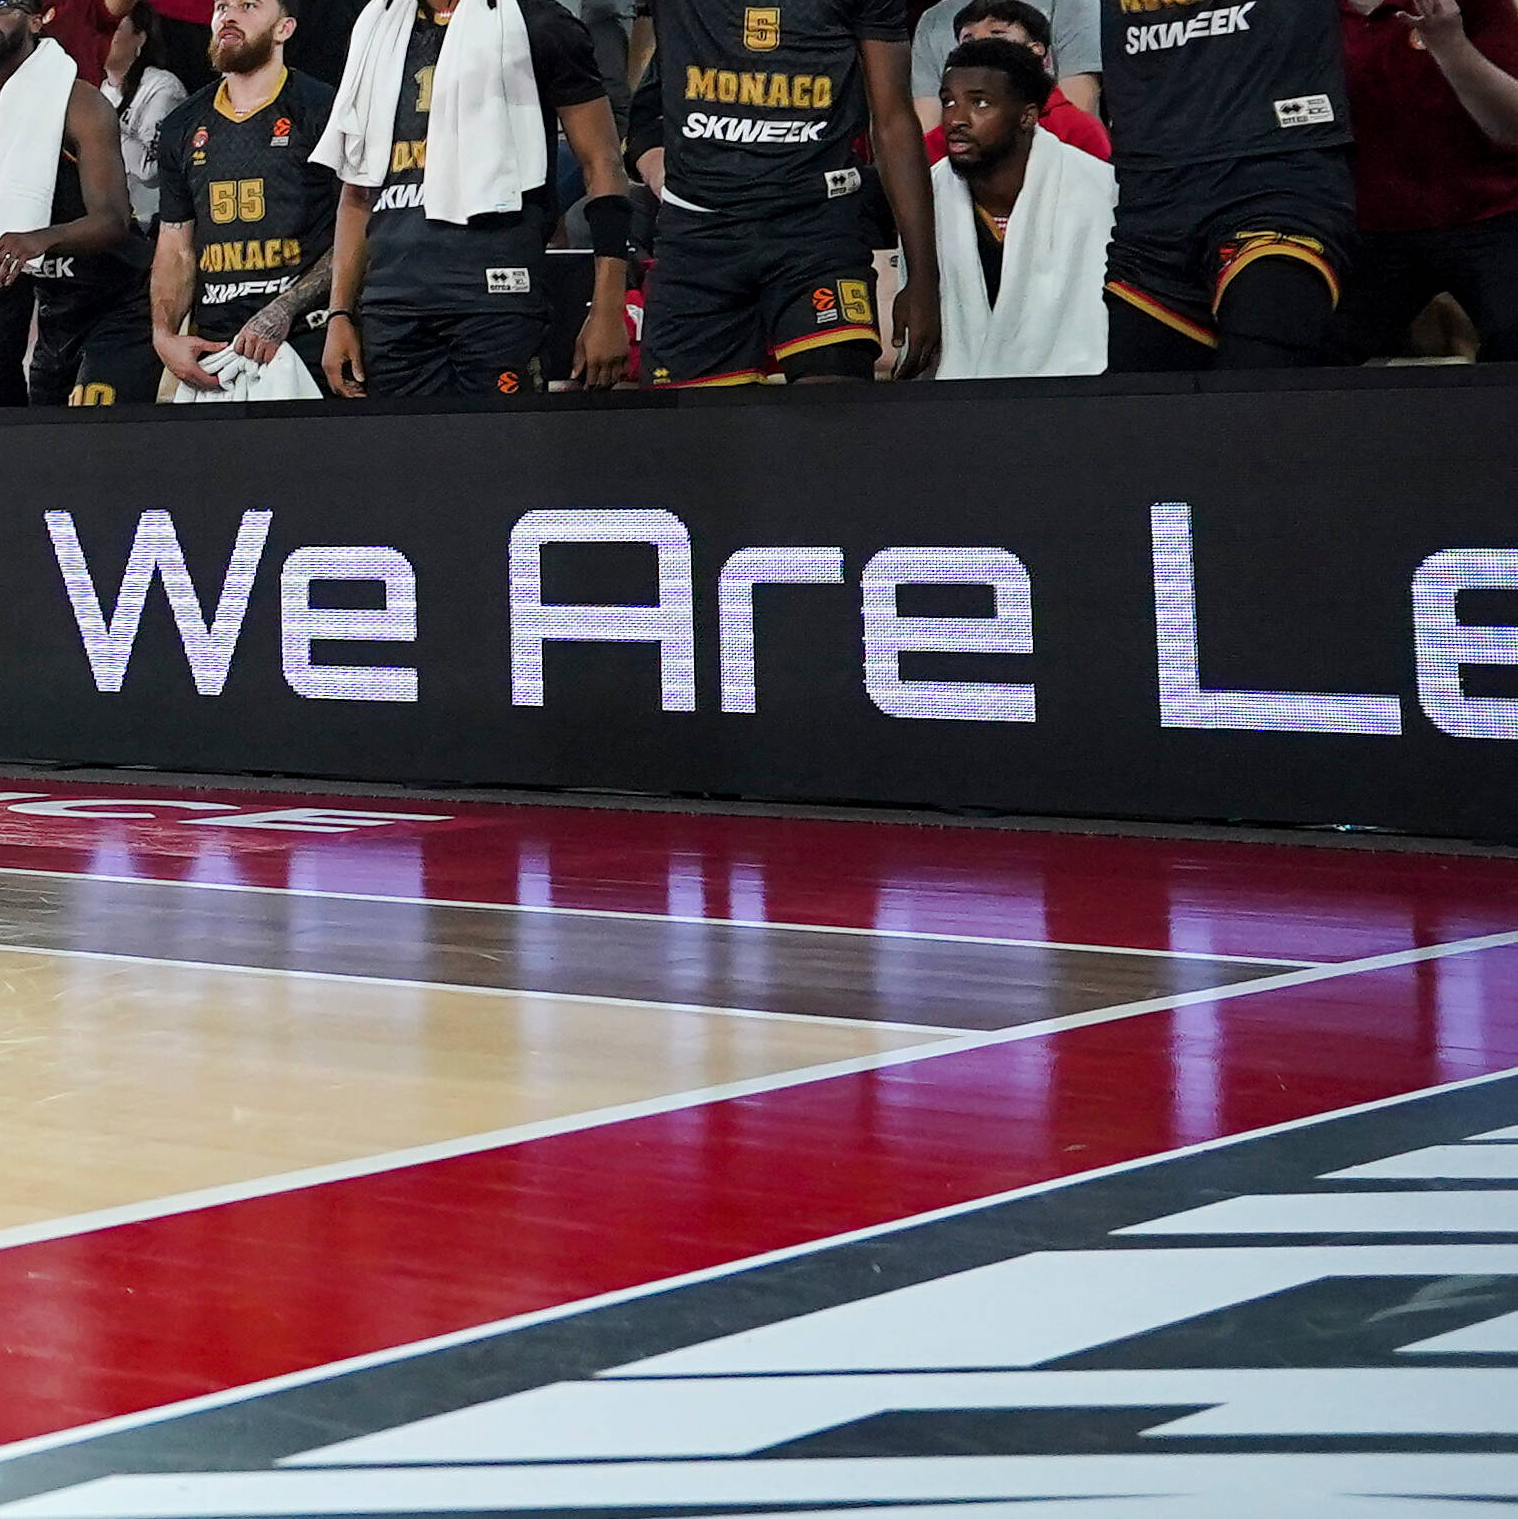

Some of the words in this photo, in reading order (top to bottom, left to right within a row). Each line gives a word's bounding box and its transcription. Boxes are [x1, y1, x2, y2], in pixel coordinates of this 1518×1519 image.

[743, 7, 781, 52] 5
[1125, 0, 1257, 55] SKWEEK
[684, 65, 834, 109] MONACO
[682, 112, 828, 143] SKWEEK
[209, 178, 266, 224] 55
[199, 238, 302, 273] MONACO
[836, 279, 874, 324] 5
[44, 508, 419, 702] We
[508, 508, 1036, 723] Are
